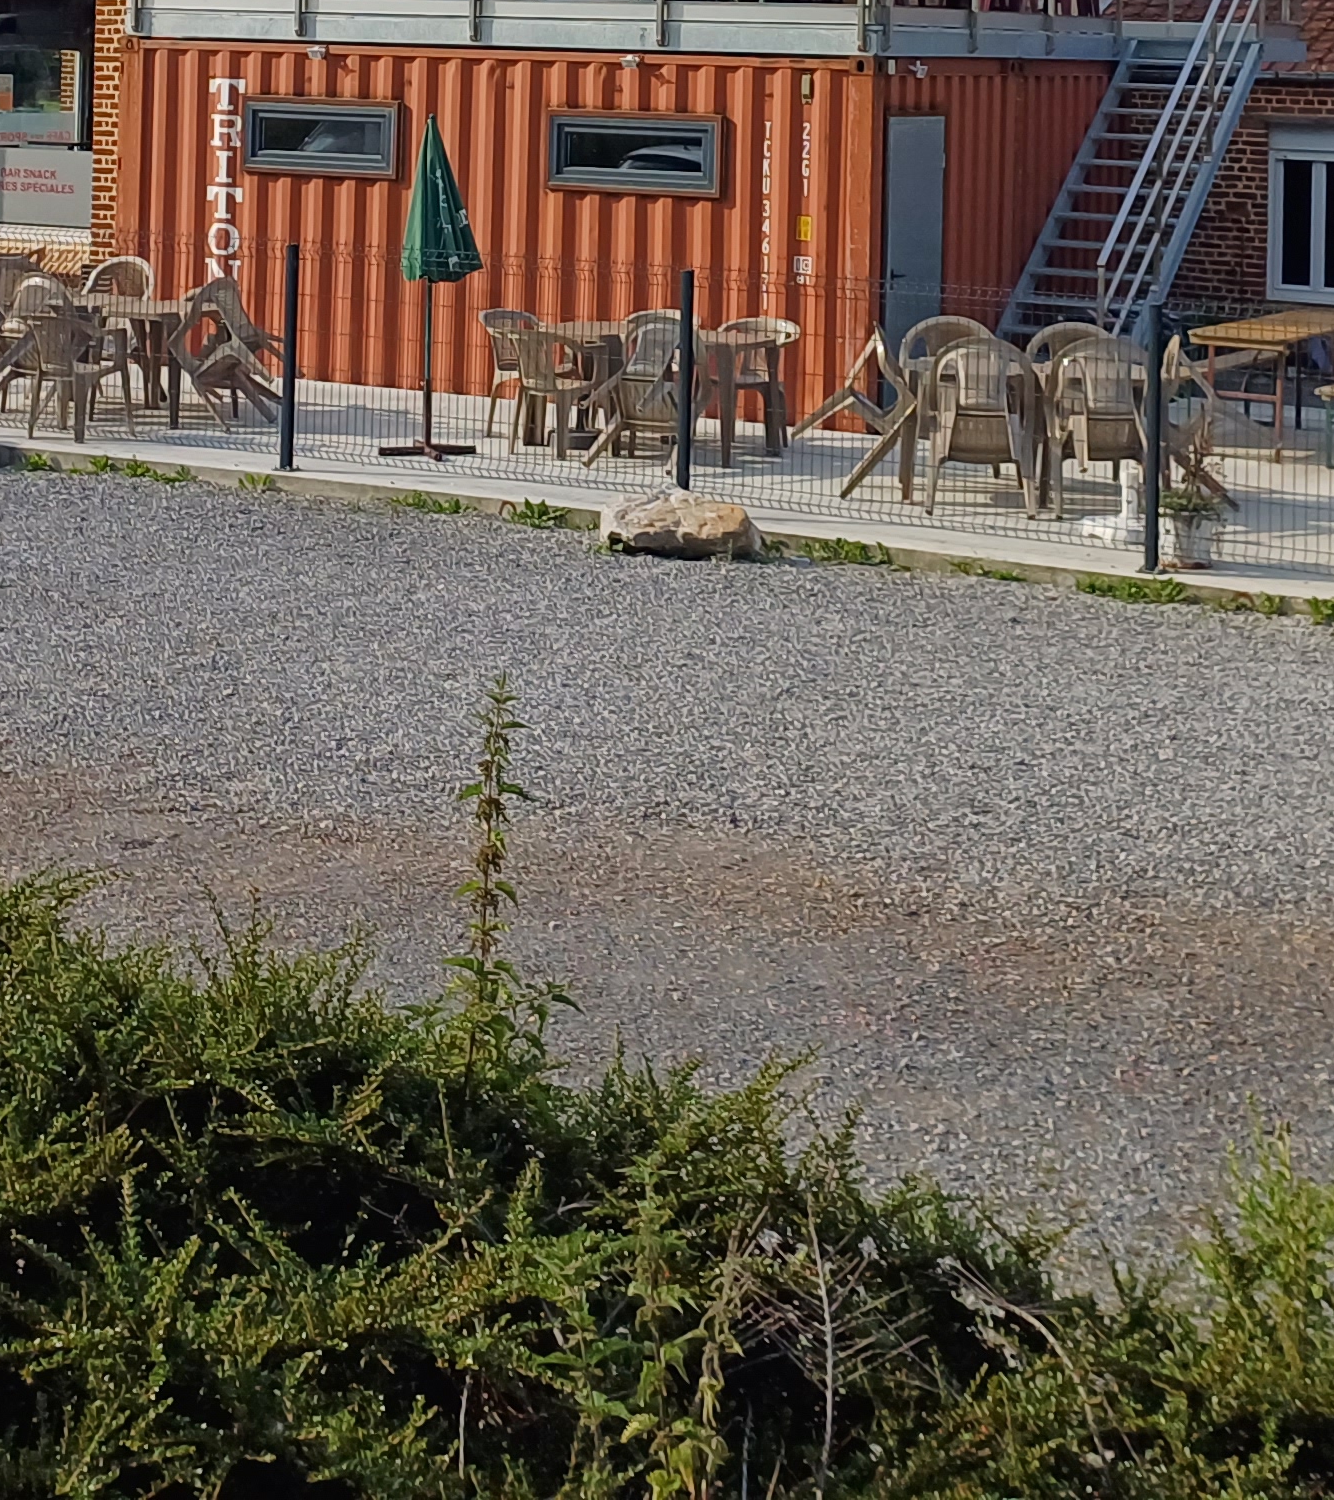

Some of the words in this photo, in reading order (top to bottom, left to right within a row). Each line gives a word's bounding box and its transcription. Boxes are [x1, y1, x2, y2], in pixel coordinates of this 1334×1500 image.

[22, 168, 57, 180] SNACK
[206, 77, 246, 284] TRITON
[762, 121, 772, 195] TCKU
[801, 122, 811, 197] 22G1
